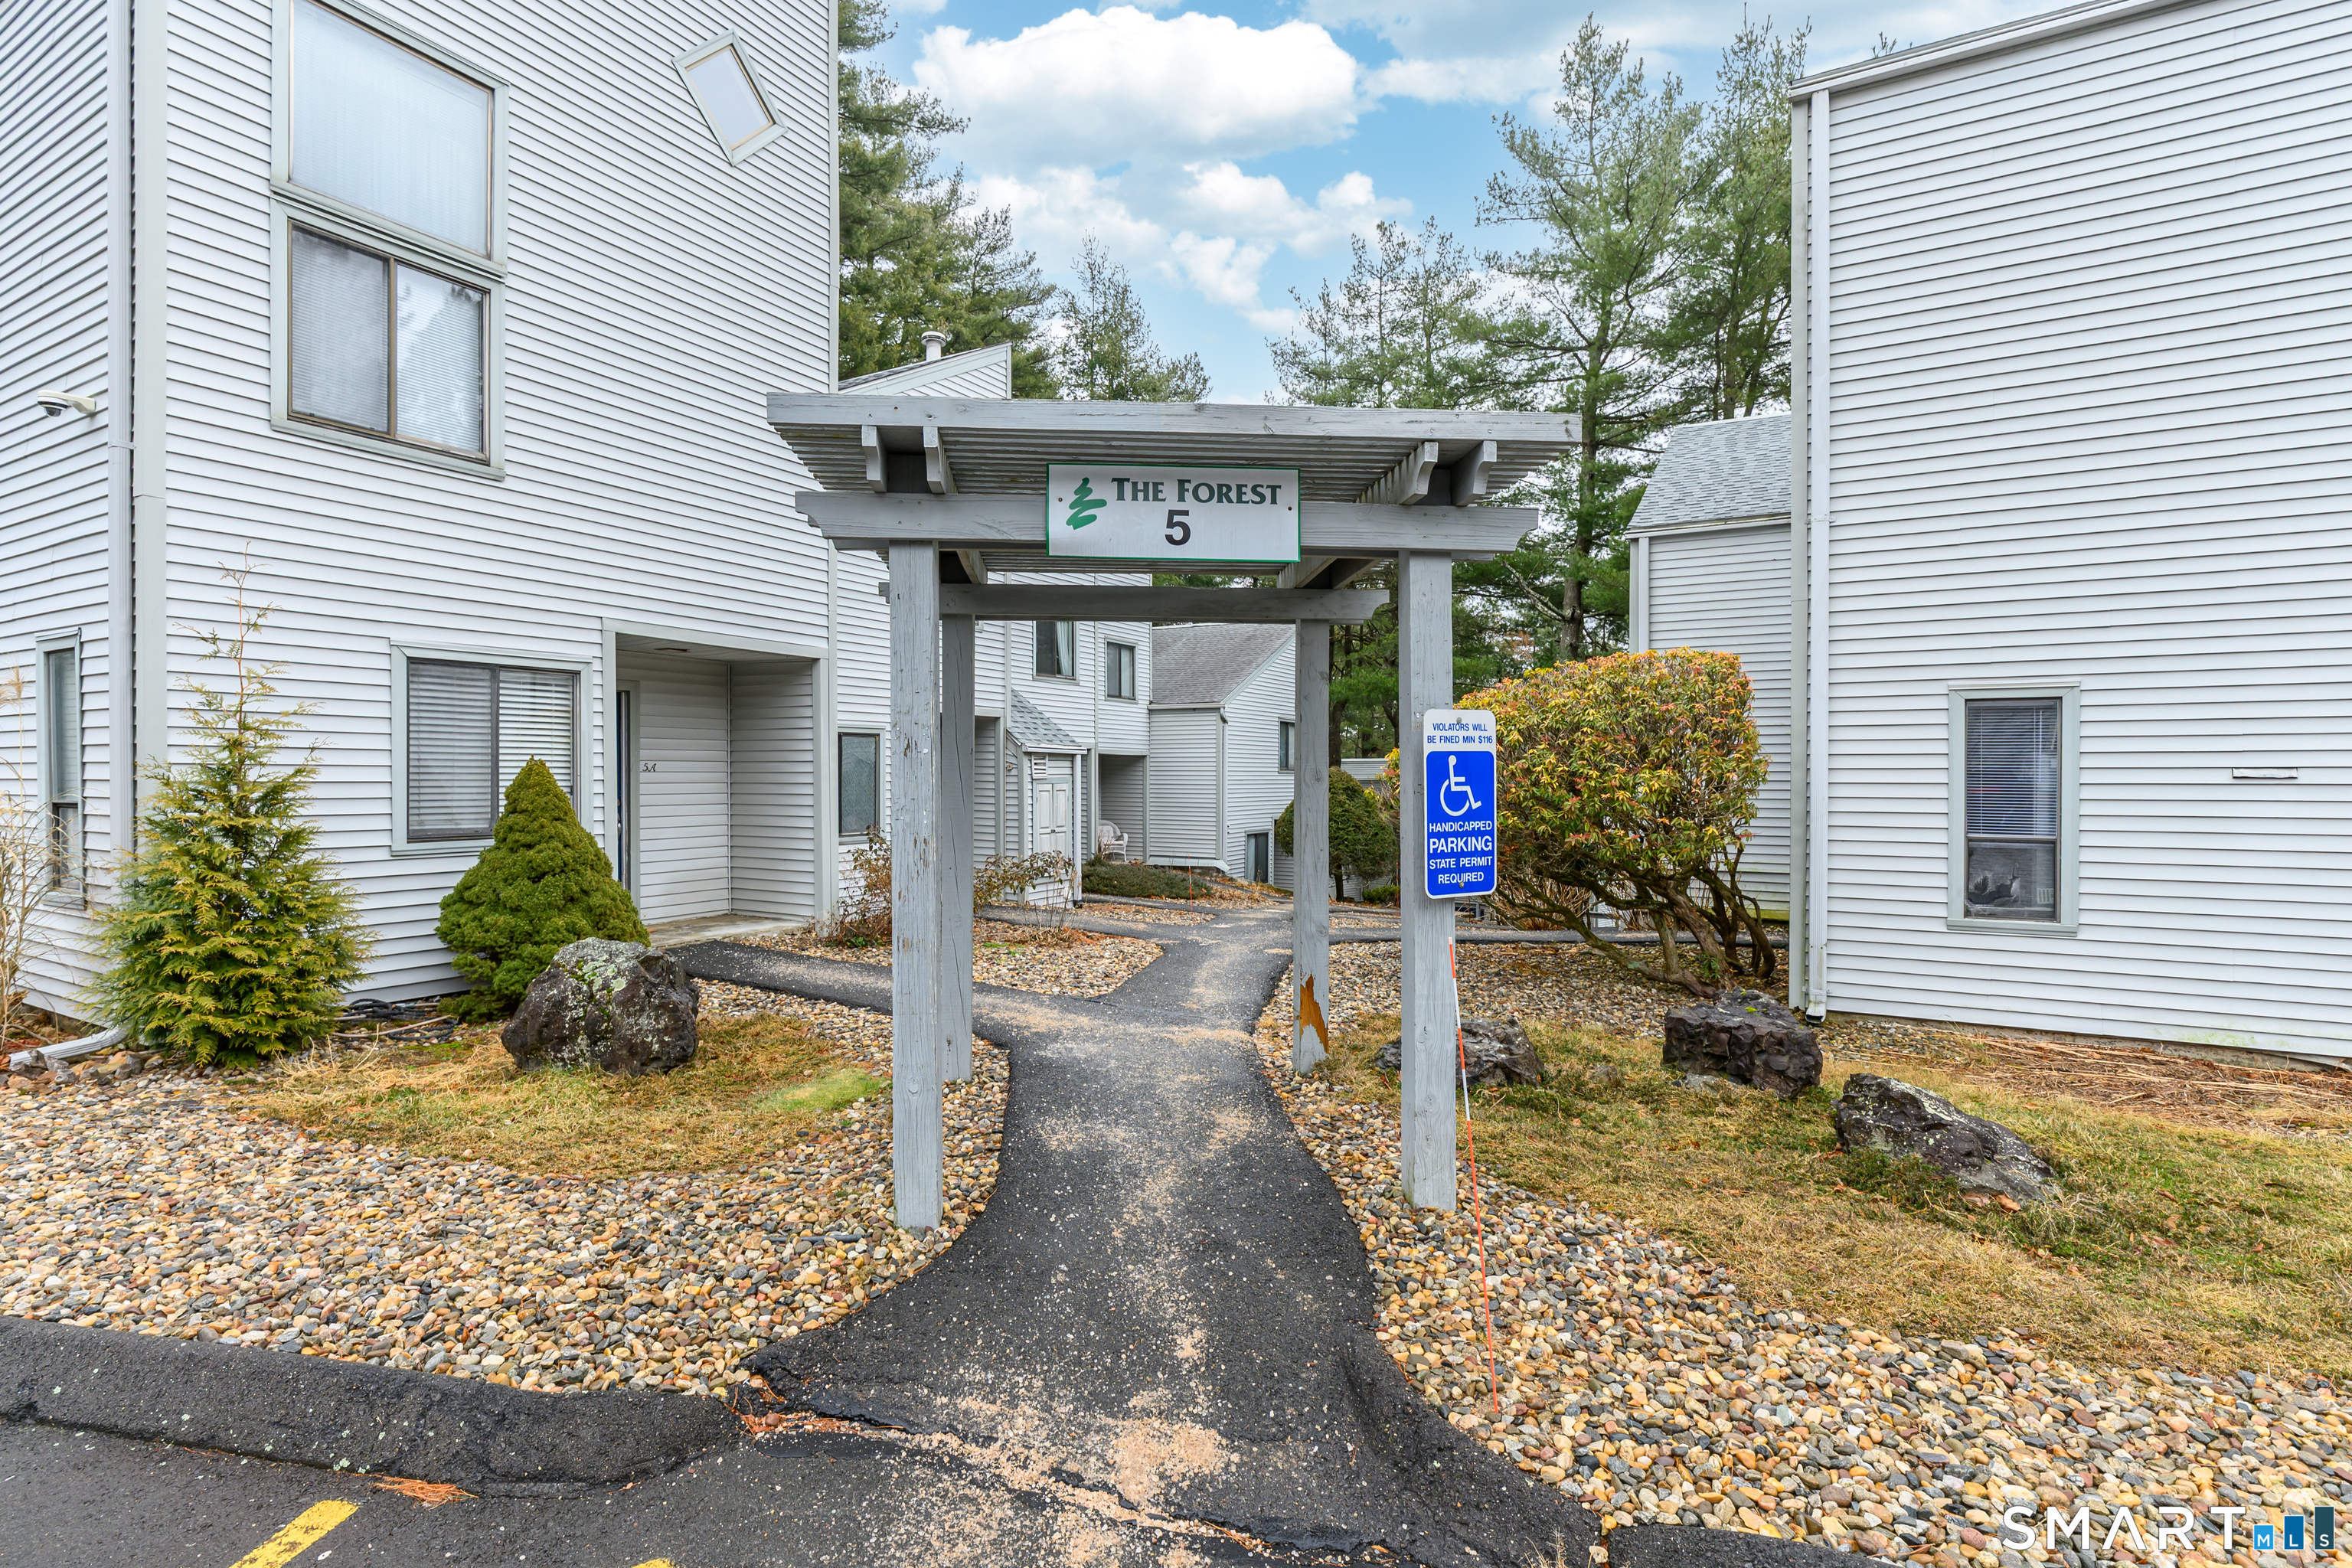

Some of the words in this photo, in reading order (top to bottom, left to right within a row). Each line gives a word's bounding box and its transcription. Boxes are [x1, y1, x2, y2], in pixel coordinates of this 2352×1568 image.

[1111, 478, 1167, 502] THE
[1176, 479, 1282, 505] FOREST
[1165, 509, 1191, 546] 5
[1432, 723, 1470, 732] VIOLATORS
[1472, 724, 1488, 732] WILL
[1427, 735, 1437, 743] BE
[1439, 735, 1460, 744] FINED
[1462, 736, 1476, 744] MIN
[1478, 735, 1493, 744] $116
[1429, 821, 1492, 833] HANDICAPPED
[1429, 835, 1493, 854] PARKING
[1429, 858, 1456, 870] STATE
[1459, 856, 1493, 867] PERMIT
[1438, 871, 1485, 884] REQUIRED
